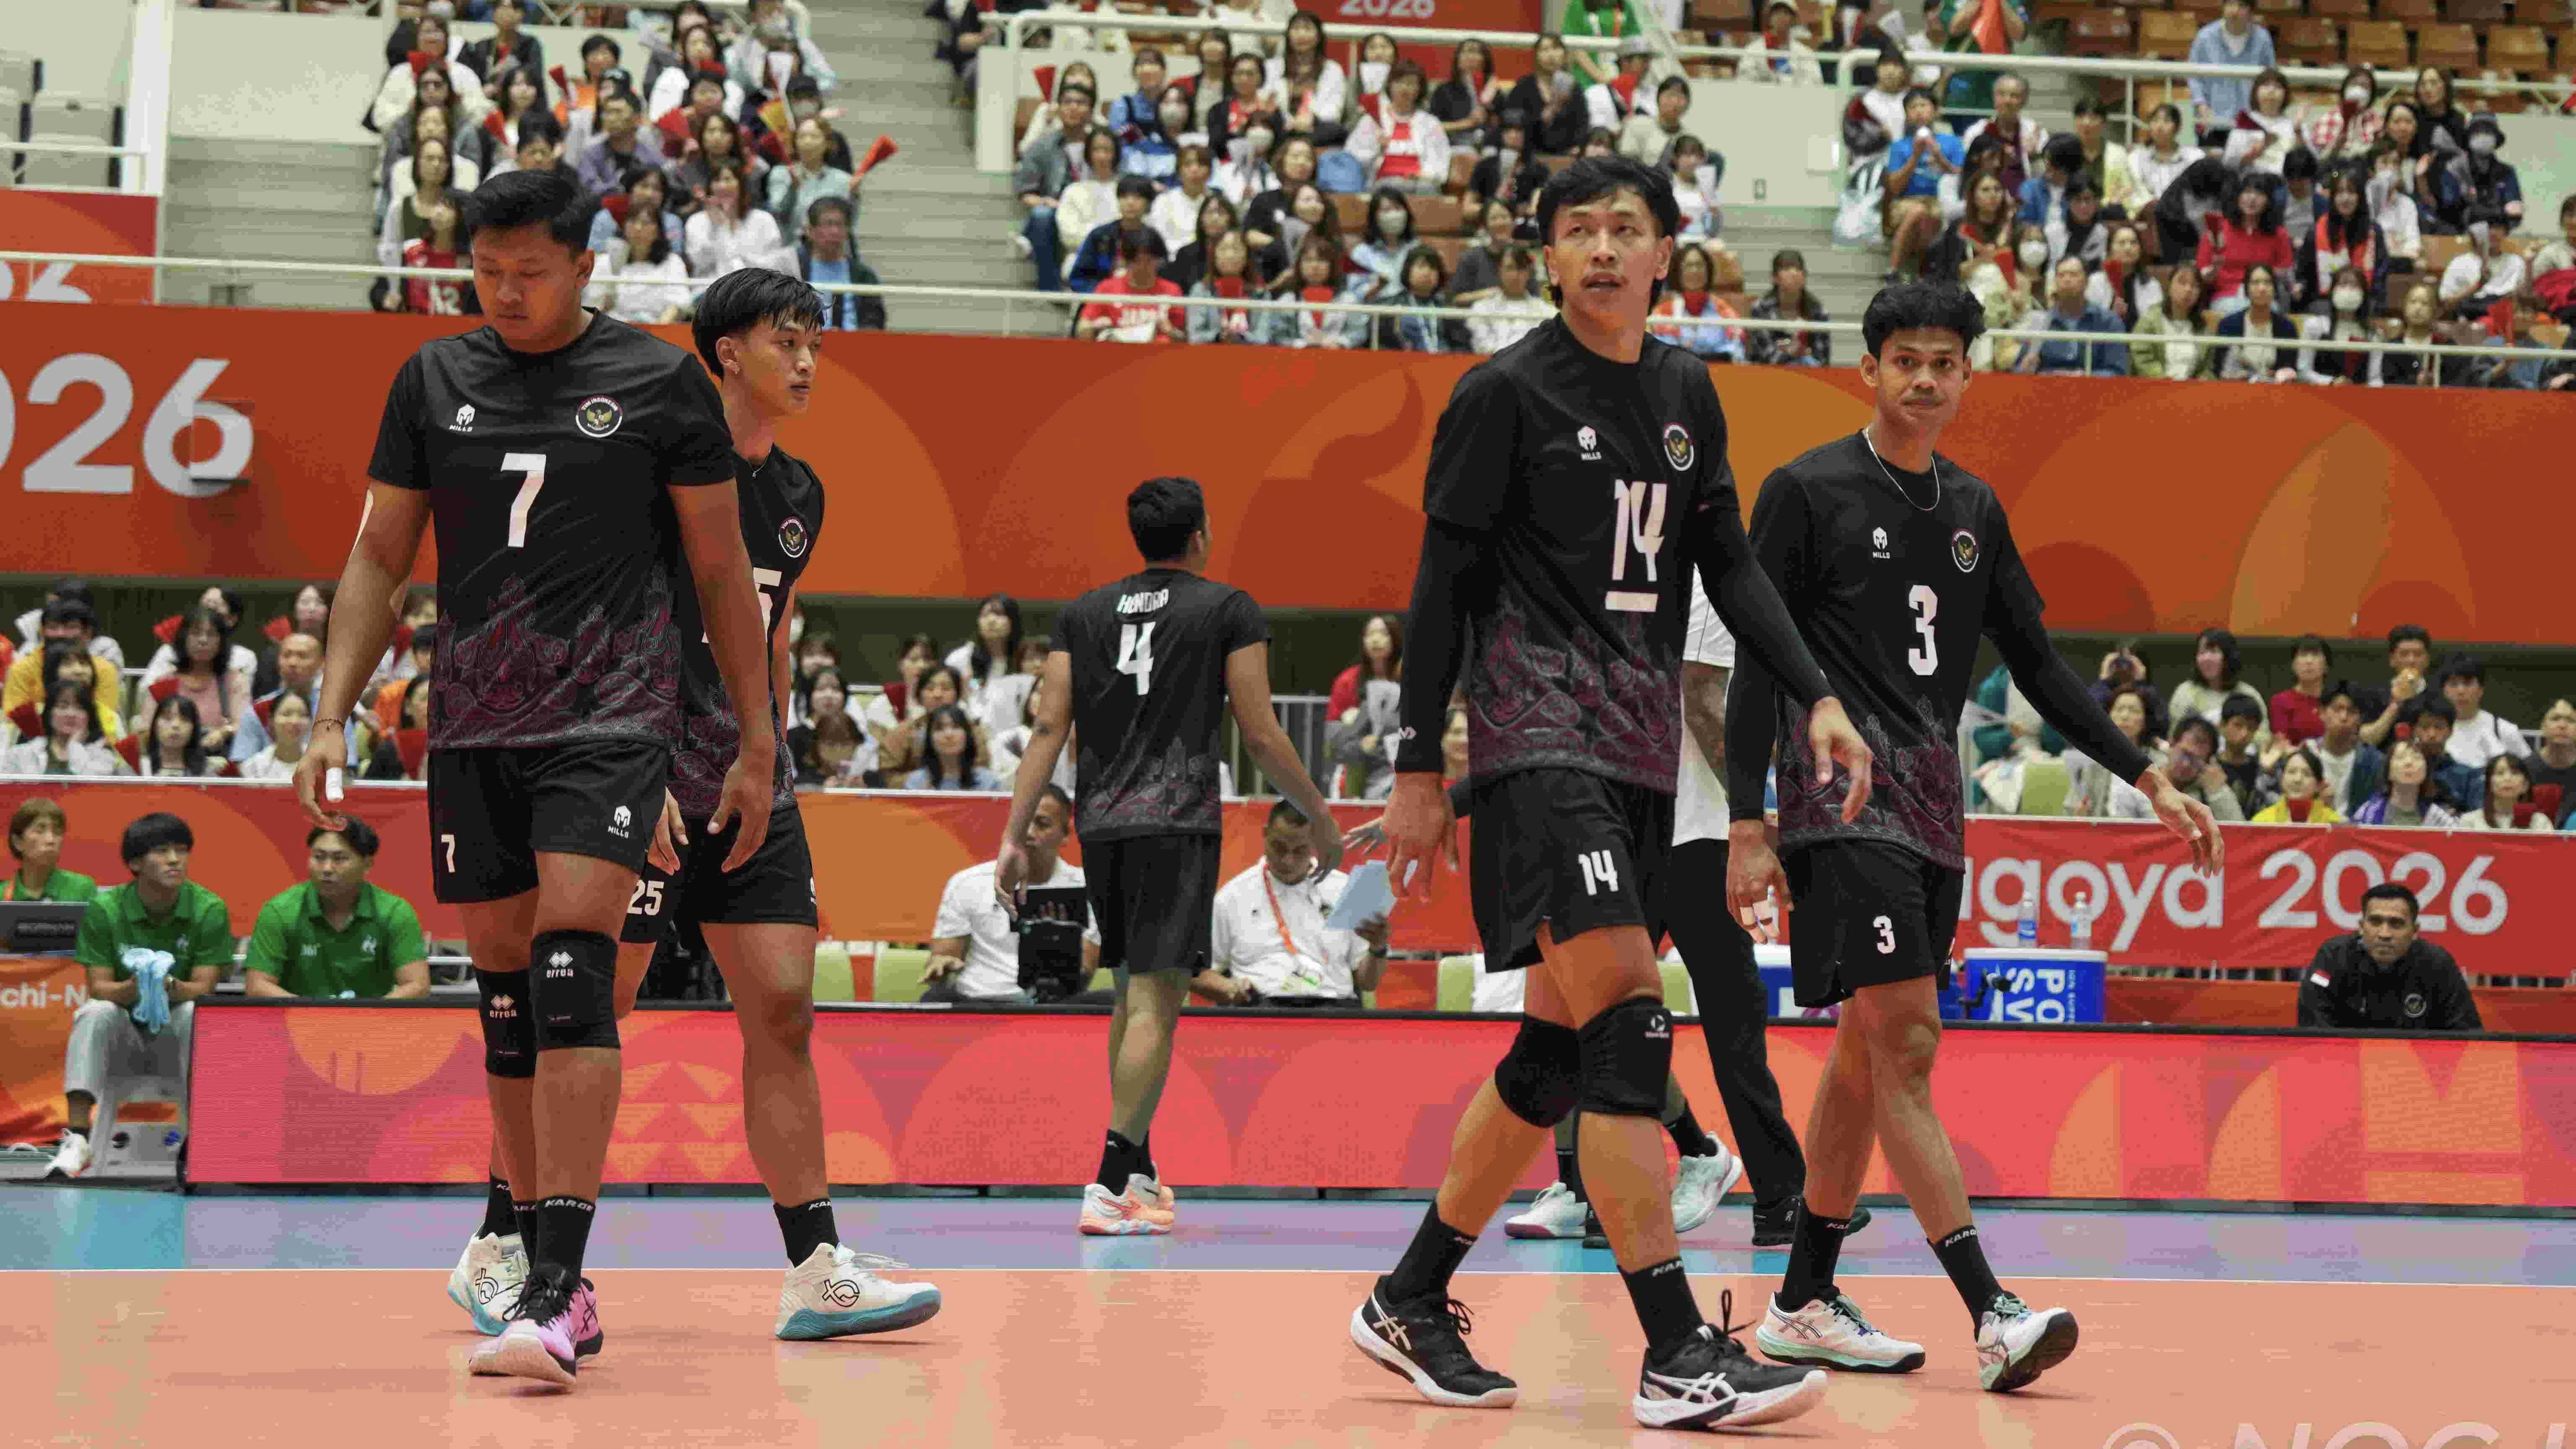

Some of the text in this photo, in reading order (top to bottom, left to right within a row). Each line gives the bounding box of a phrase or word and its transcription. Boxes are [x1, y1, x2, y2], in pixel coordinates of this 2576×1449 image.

[0, 352, 254, 498] 26
[500, 452, 546, 548] 7
[1612, 479, 1667, 582] 14
[1116, 621, 1157, 696] 4
[1908, 584, 1938, 675] 3
[441, 834, 456, 873] 7
[1578, 849, 1619, 896] 14
[627, 879, 665, 916] 25
[1872, 915, 1896, 954] 3
[1959, 848, 2508, 952] goya 2026
